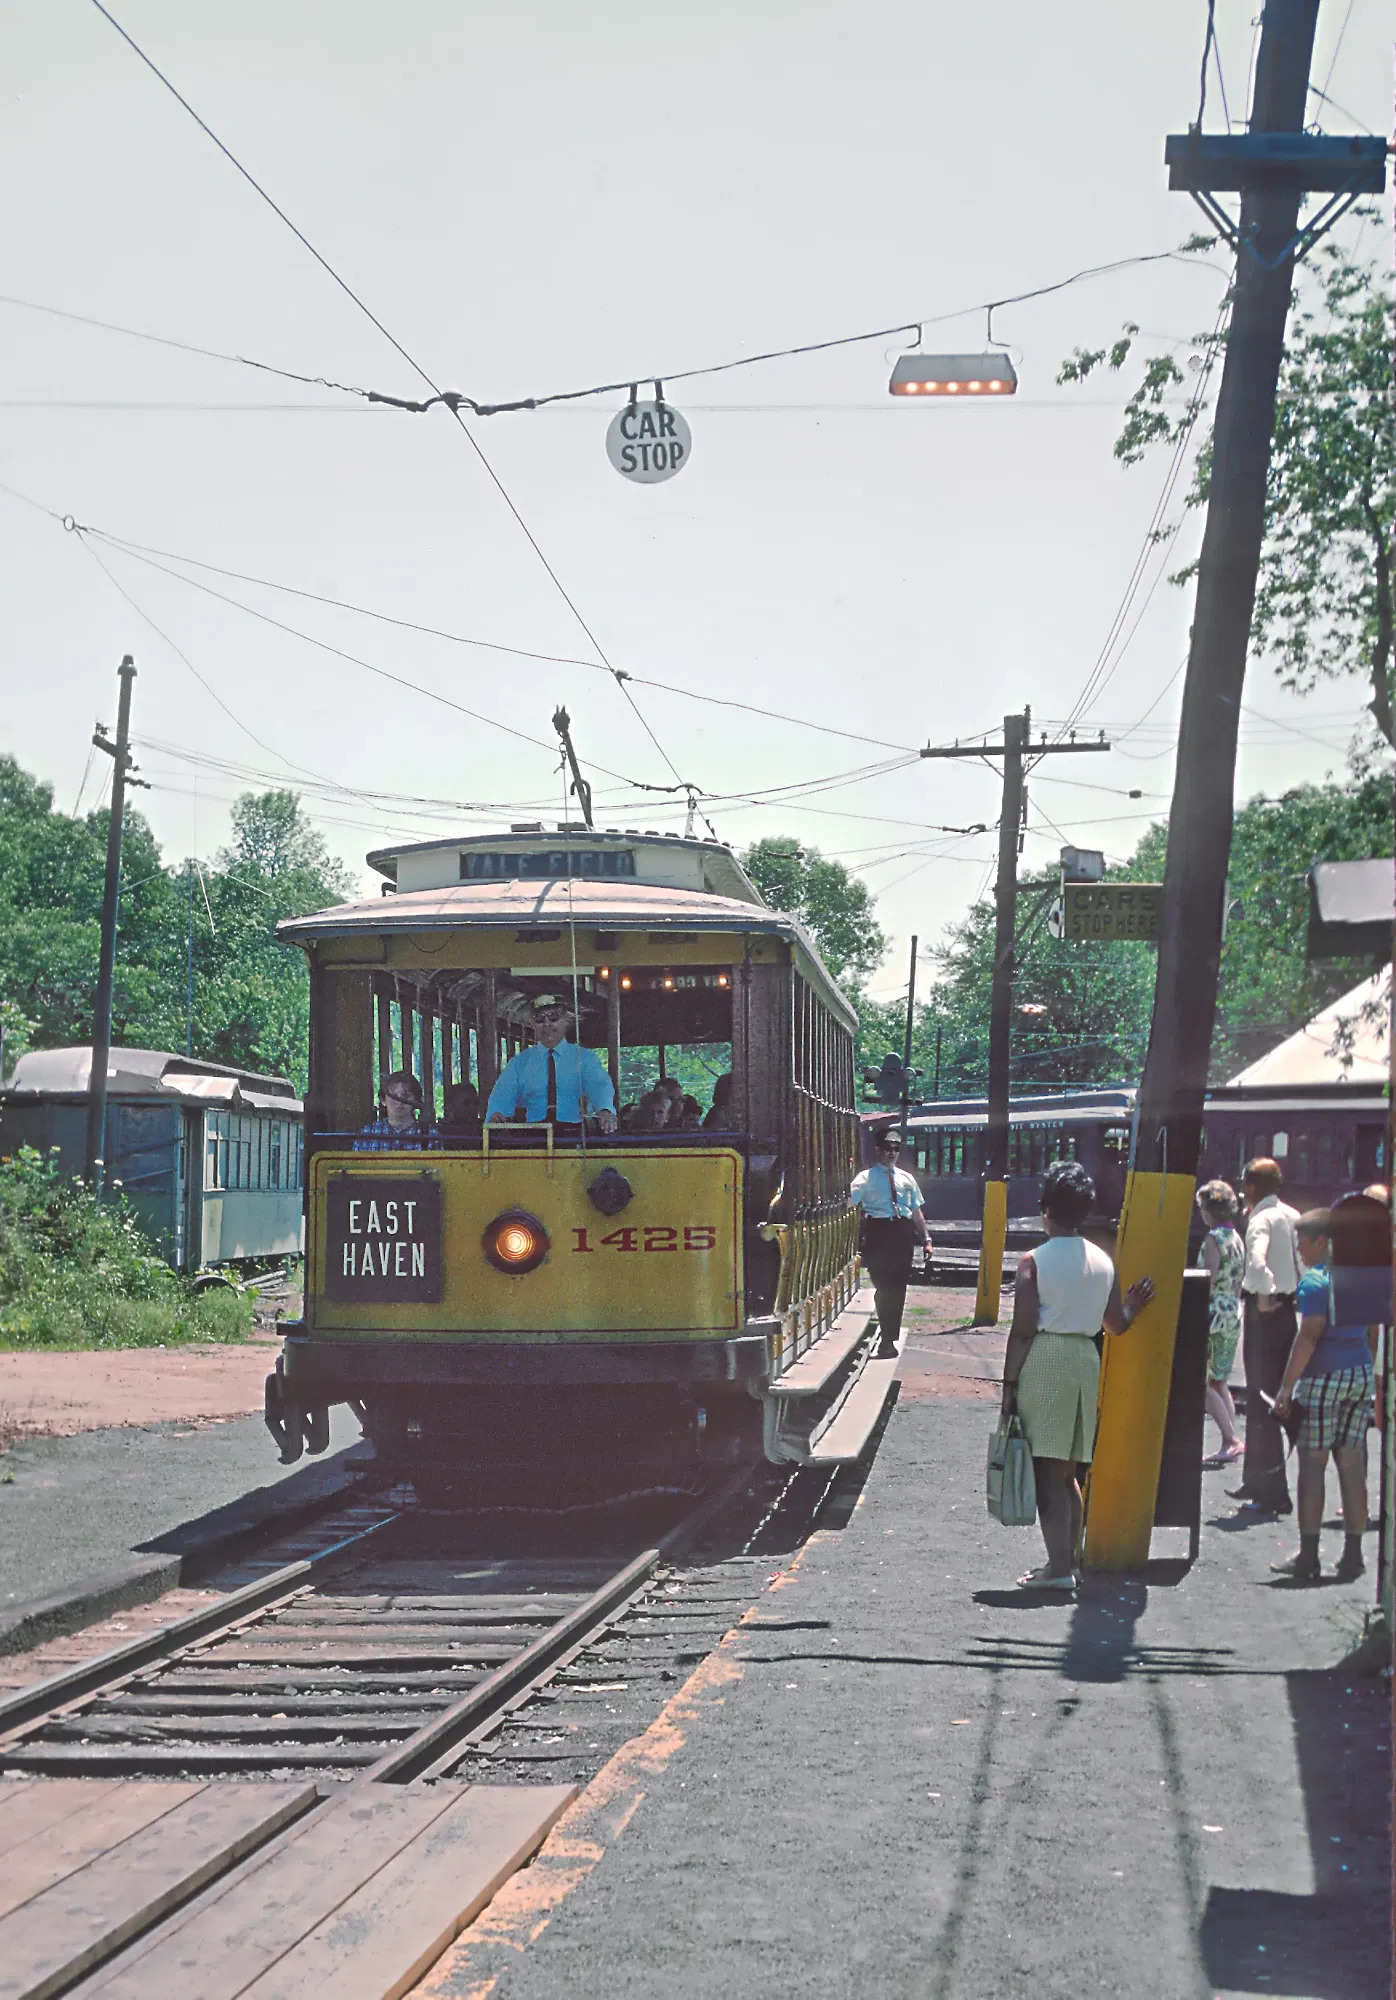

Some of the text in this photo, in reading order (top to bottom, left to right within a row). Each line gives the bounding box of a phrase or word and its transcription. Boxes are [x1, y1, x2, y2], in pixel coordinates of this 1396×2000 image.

[620, 411, 677, 440] CAR
[620, 441, 684, 473] STOP
[467, 851, 630, 877] YALE FIELD
[1073, 890, 1157, 911] CARS
[1071, 913, 1158, 934] STOP HERE
[1029, 1120, 1064, 1129] SYSTEM
[349, 1200, 417, 1235] EAST
[571, 1226, 717, 1253] 1425
[343, 1241, 425, 1277] HAVEN
